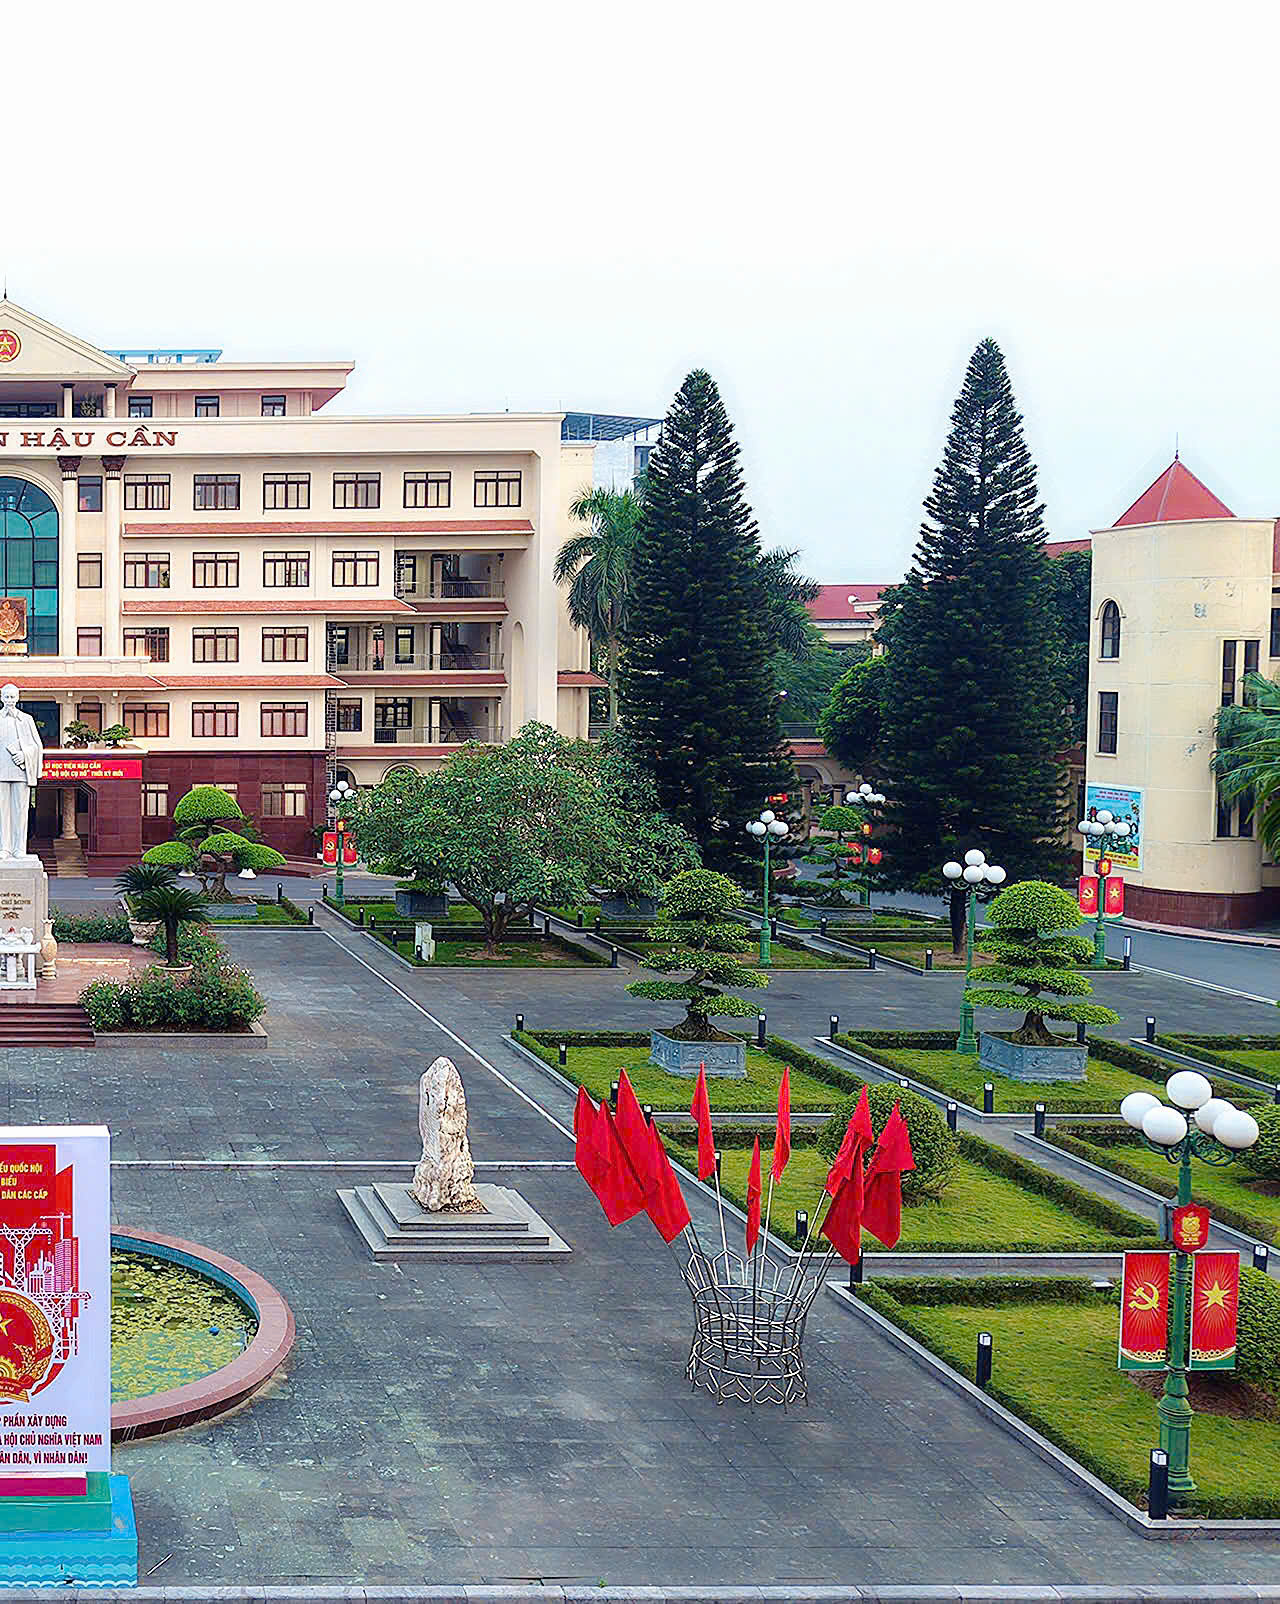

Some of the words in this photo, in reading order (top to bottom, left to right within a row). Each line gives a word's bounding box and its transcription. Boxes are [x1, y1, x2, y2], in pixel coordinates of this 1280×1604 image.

[20, 427, 96, 451] HẬU
[106, 424, 179, 447] CẦN
[10, 1161, 29, 1173] QUỐC
[30, 1162, 43, 1174] HỘI
[1, 1175, 17, 1186] BIỂU
[1, 1189, 16, 1199] DÂN
[17, 1189, 32, 1199] CÁC
[33, 1188, 48, 1199] CẤP
[3, 1412, 25, 1427] PHẦN
[27, 1414, 43, 1427] XÂY
[45, 1414, 67, 1429] DỰNG
[4, 1432, 18, 1447] HỘI
[20, 1431, 36, 1445] CHỦ
[38, 1432, 63, 1445] NGHĨA
[64, 1432, 81, 1447] VIỆT
[83, 1434, 102, 1445] NAM
[12, 1451, 32, 1464] DÂN,
[34, 1451, 42, 1464] VÌ
[43, 1451, 66, 1464] NHÂN
[68, 1451, 88, 1464] DÂN!
